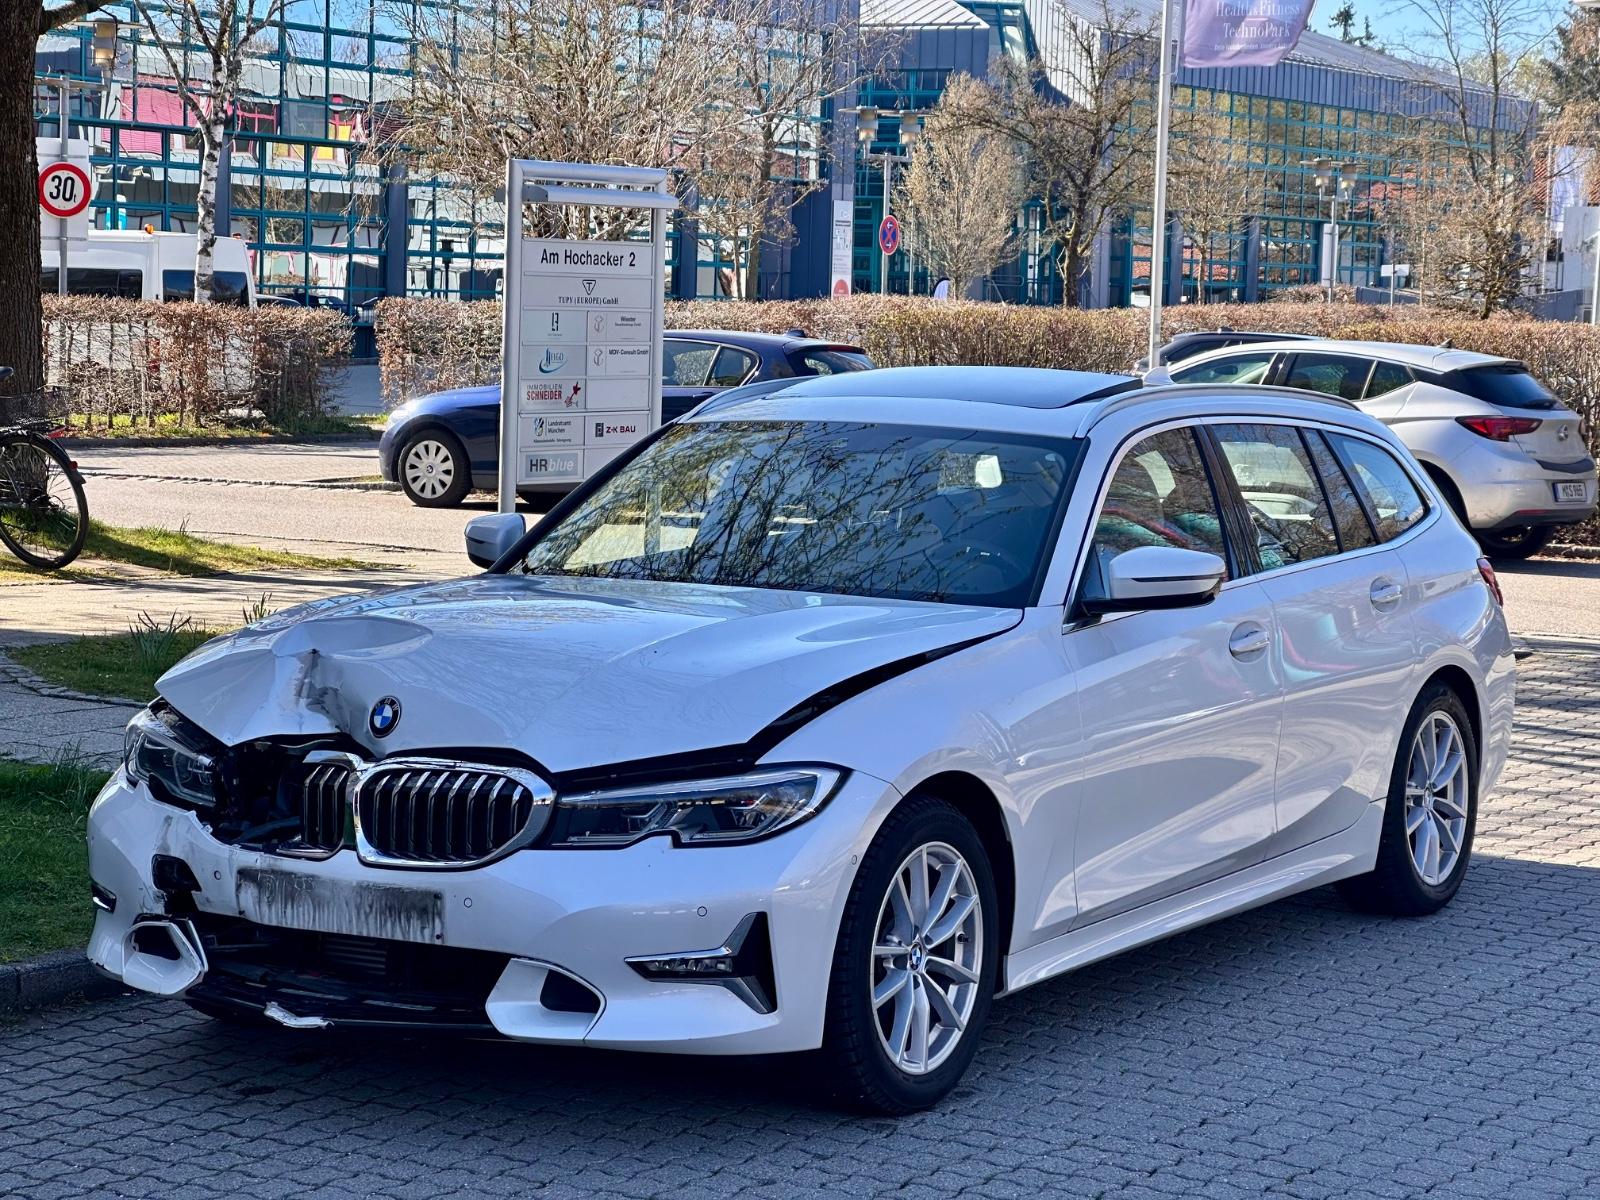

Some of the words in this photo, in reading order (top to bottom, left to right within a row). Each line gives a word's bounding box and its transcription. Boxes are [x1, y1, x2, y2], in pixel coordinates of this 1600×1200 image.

[1223, 21, 1290, 39] TechnoPark
[540, 248, 559, 265] Am
[564, 249, 624, 267] Hochacker
[629, 251, 636, 267] 2
[526, 383, 562, 391] IMMOBILIEN
[526, 390, 562, 400] SCHNEIDER
[619, 425, 636, 433] BAU
